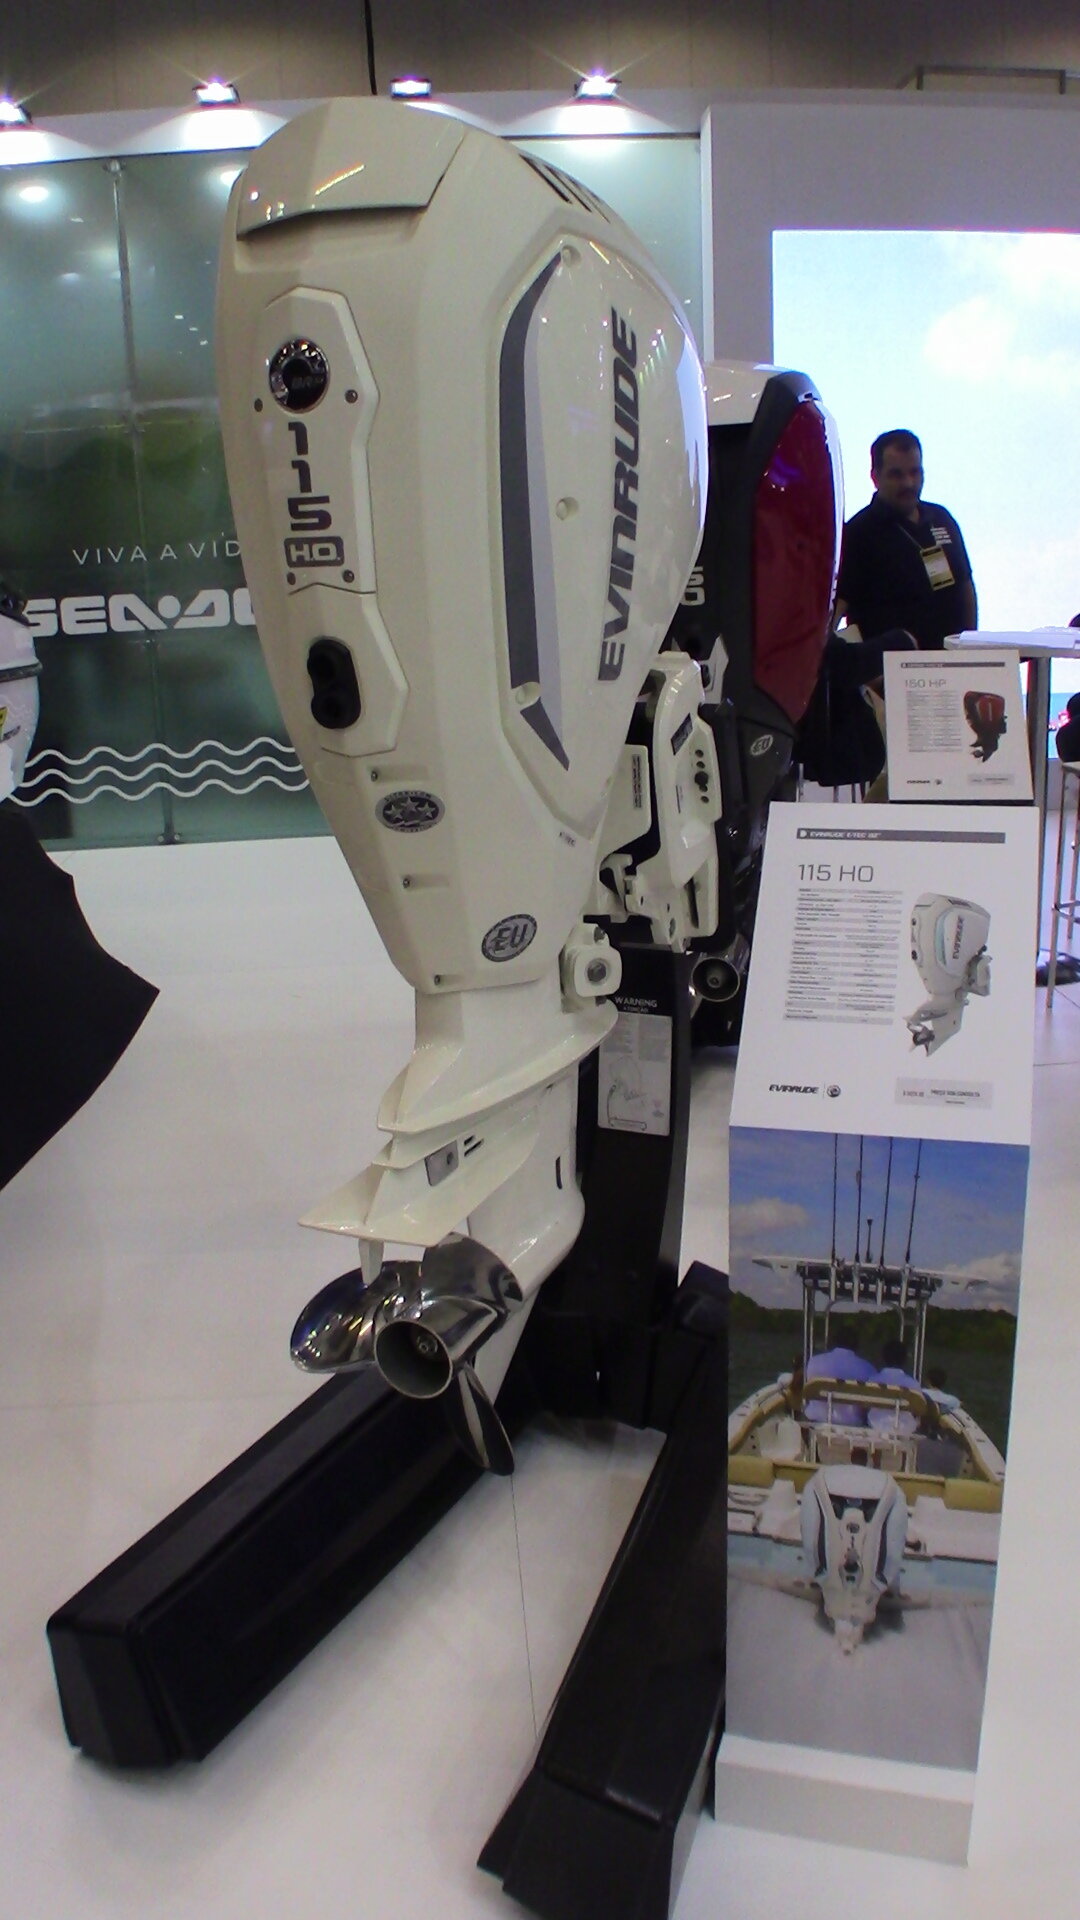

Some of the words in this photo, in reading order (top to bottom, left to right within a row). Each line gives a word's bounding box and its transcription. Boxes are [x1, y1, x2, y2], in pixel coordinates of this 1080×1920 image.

[288, 421, 332, 531] 115
[598, 306, 639, 681] EVINRUDE
[73, 545, 147, 565] VIVA
[160, 544, 177, 560] A
[188, 540, 241, 558] VID
[798, 864, 832, 881] 115
[839, 865, 874, 883] HO
[614, 996, 658, 1008] WARNING
[769, 1083, 820, 1094] EVINRUDE
